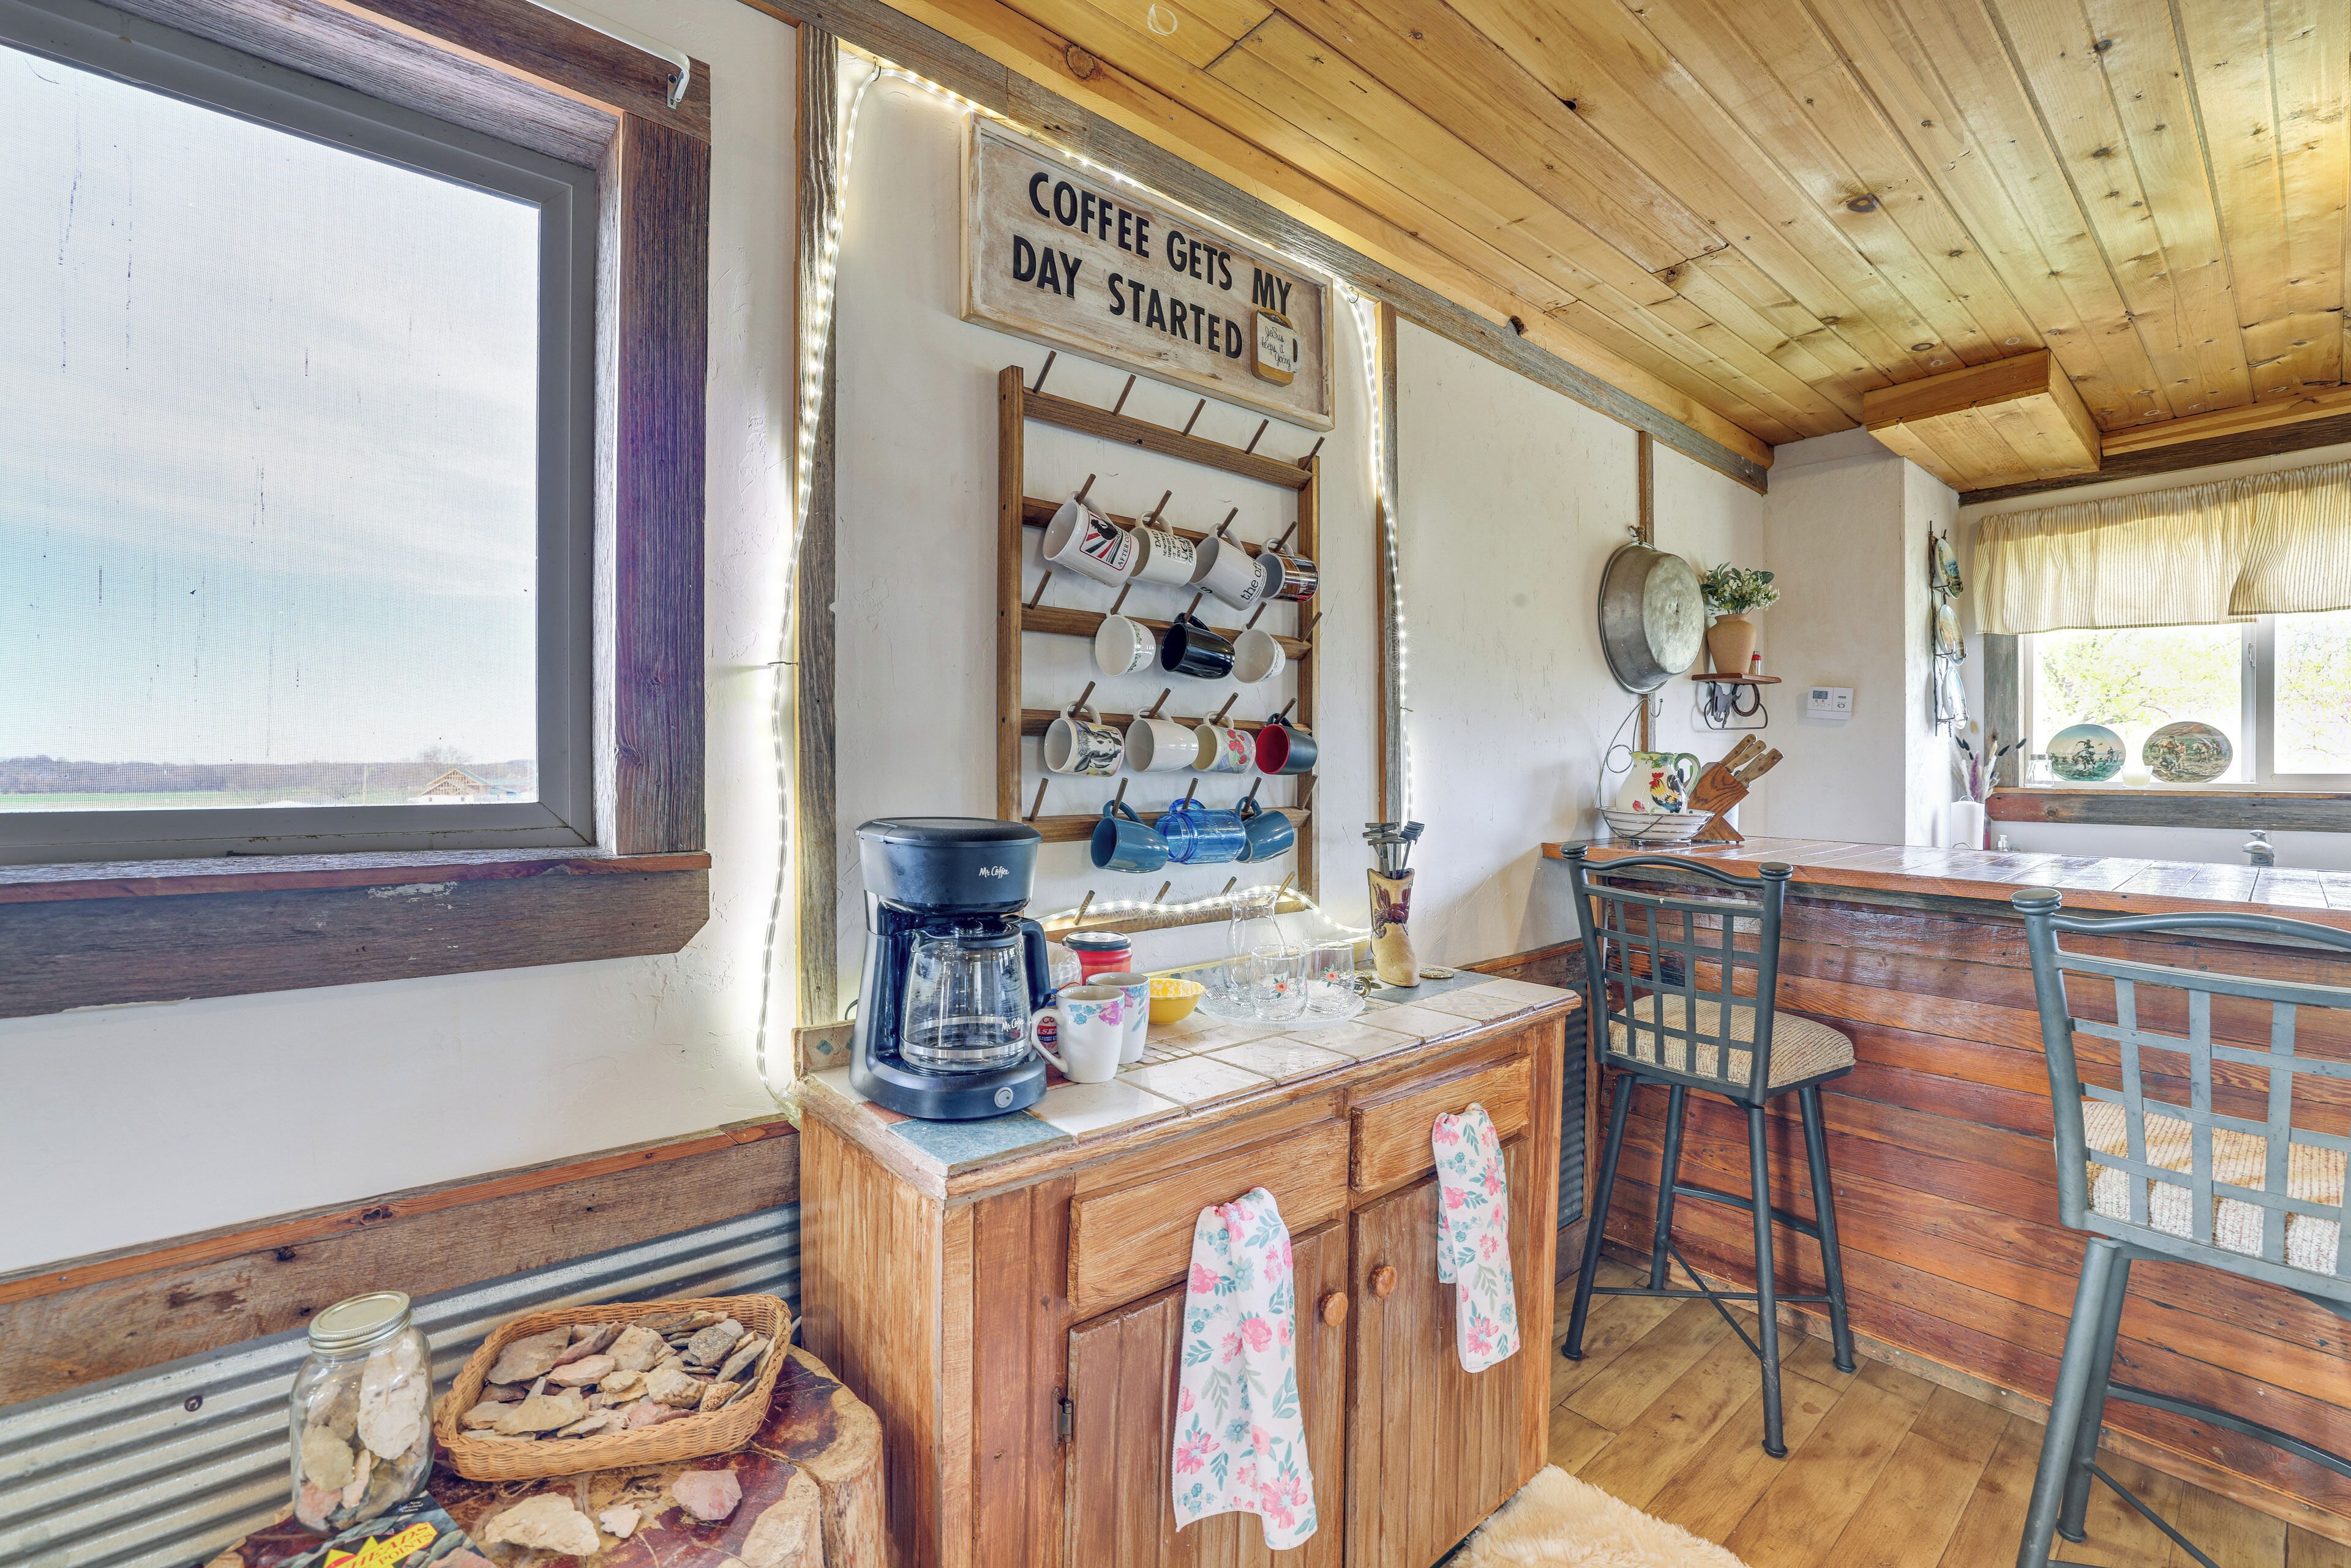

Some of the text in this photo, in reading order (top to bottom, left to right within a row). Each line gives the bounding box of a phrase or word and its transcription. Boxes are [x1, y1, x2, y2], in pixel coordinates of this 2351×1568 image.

[1029, 172, 1293, 315] COFFEE GETS MY
[1013, 234, 1242, 359] DAY STARTED
[1261, 337, 1284, 354] keeps it
[1152, 530, 1161, 548] DAD
[1118, 544, 1129, 567] AFTER
[1240, 579, 1259, 601] the
[979, 866, 1010, 879] Mr. Coffee
[378, 1532, 433, 1564] POINTS
